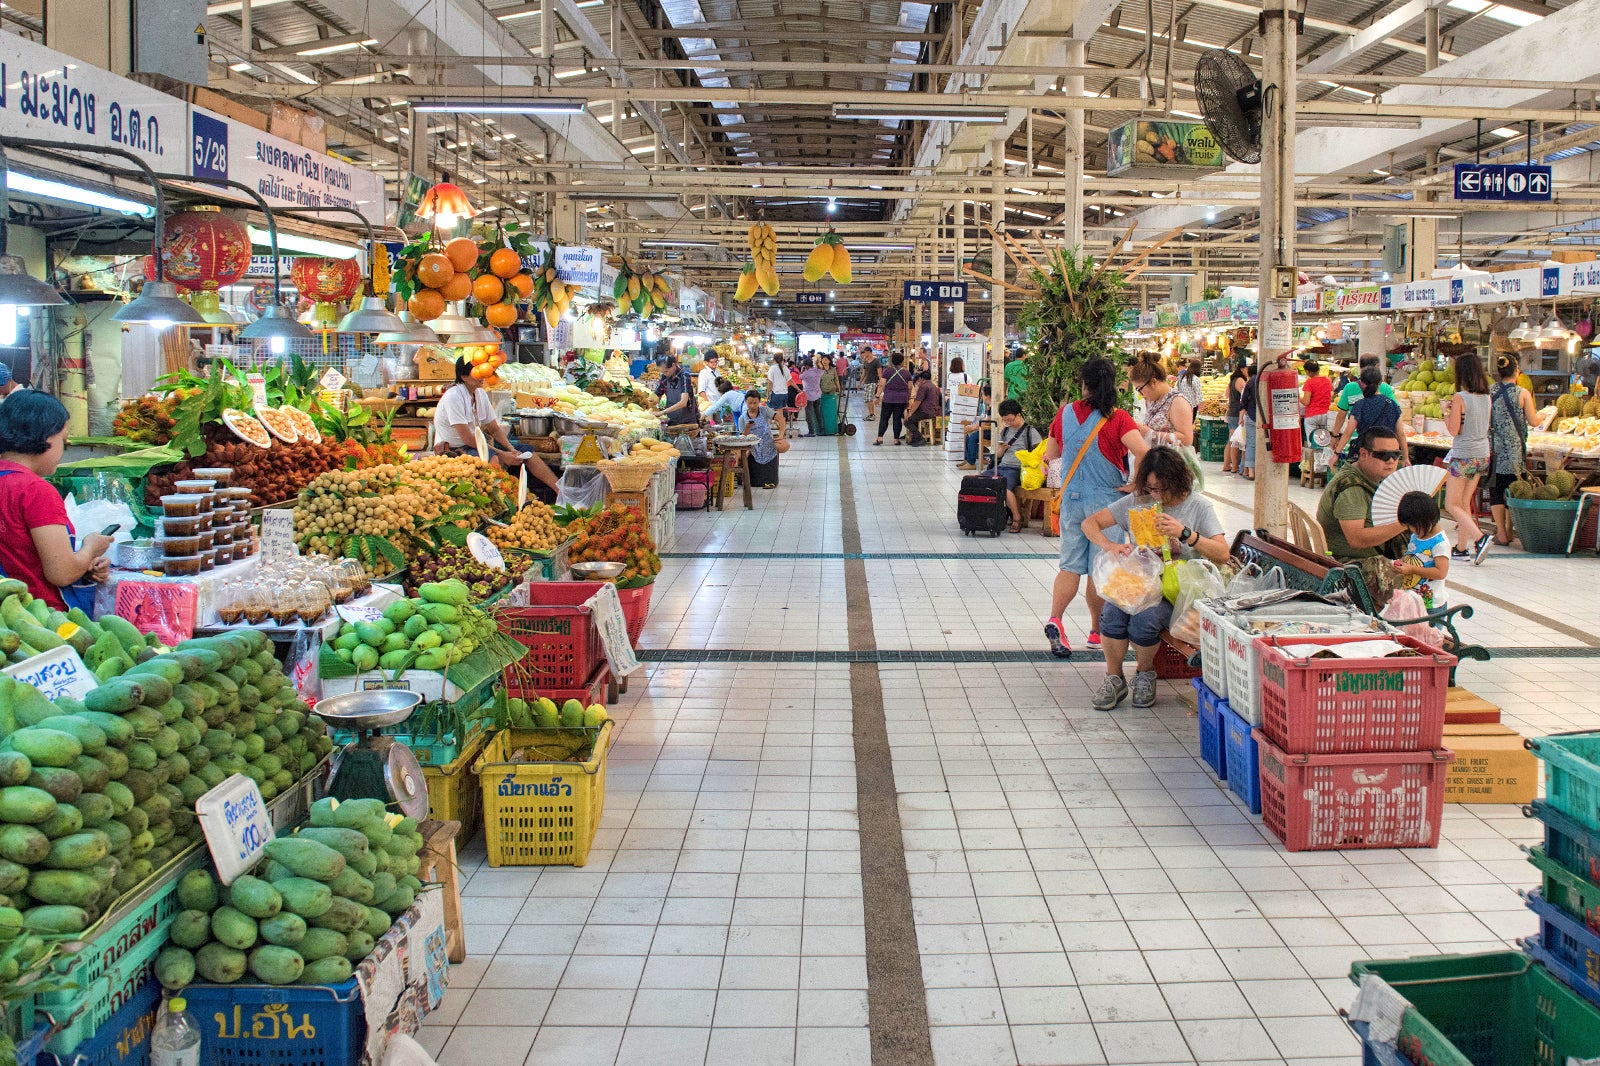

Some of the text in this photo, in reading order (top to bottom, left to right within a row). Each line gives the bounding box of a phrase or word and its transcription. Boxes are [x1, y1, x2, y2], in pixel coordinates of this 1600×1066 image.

[21, 66, 96, 134] มะม่วง
[109, 102, 164, 156] อ.ต.ก.
[195, 135, 226, 173] 5/28
[256, 141, 319, 181] มงคลพานิช
